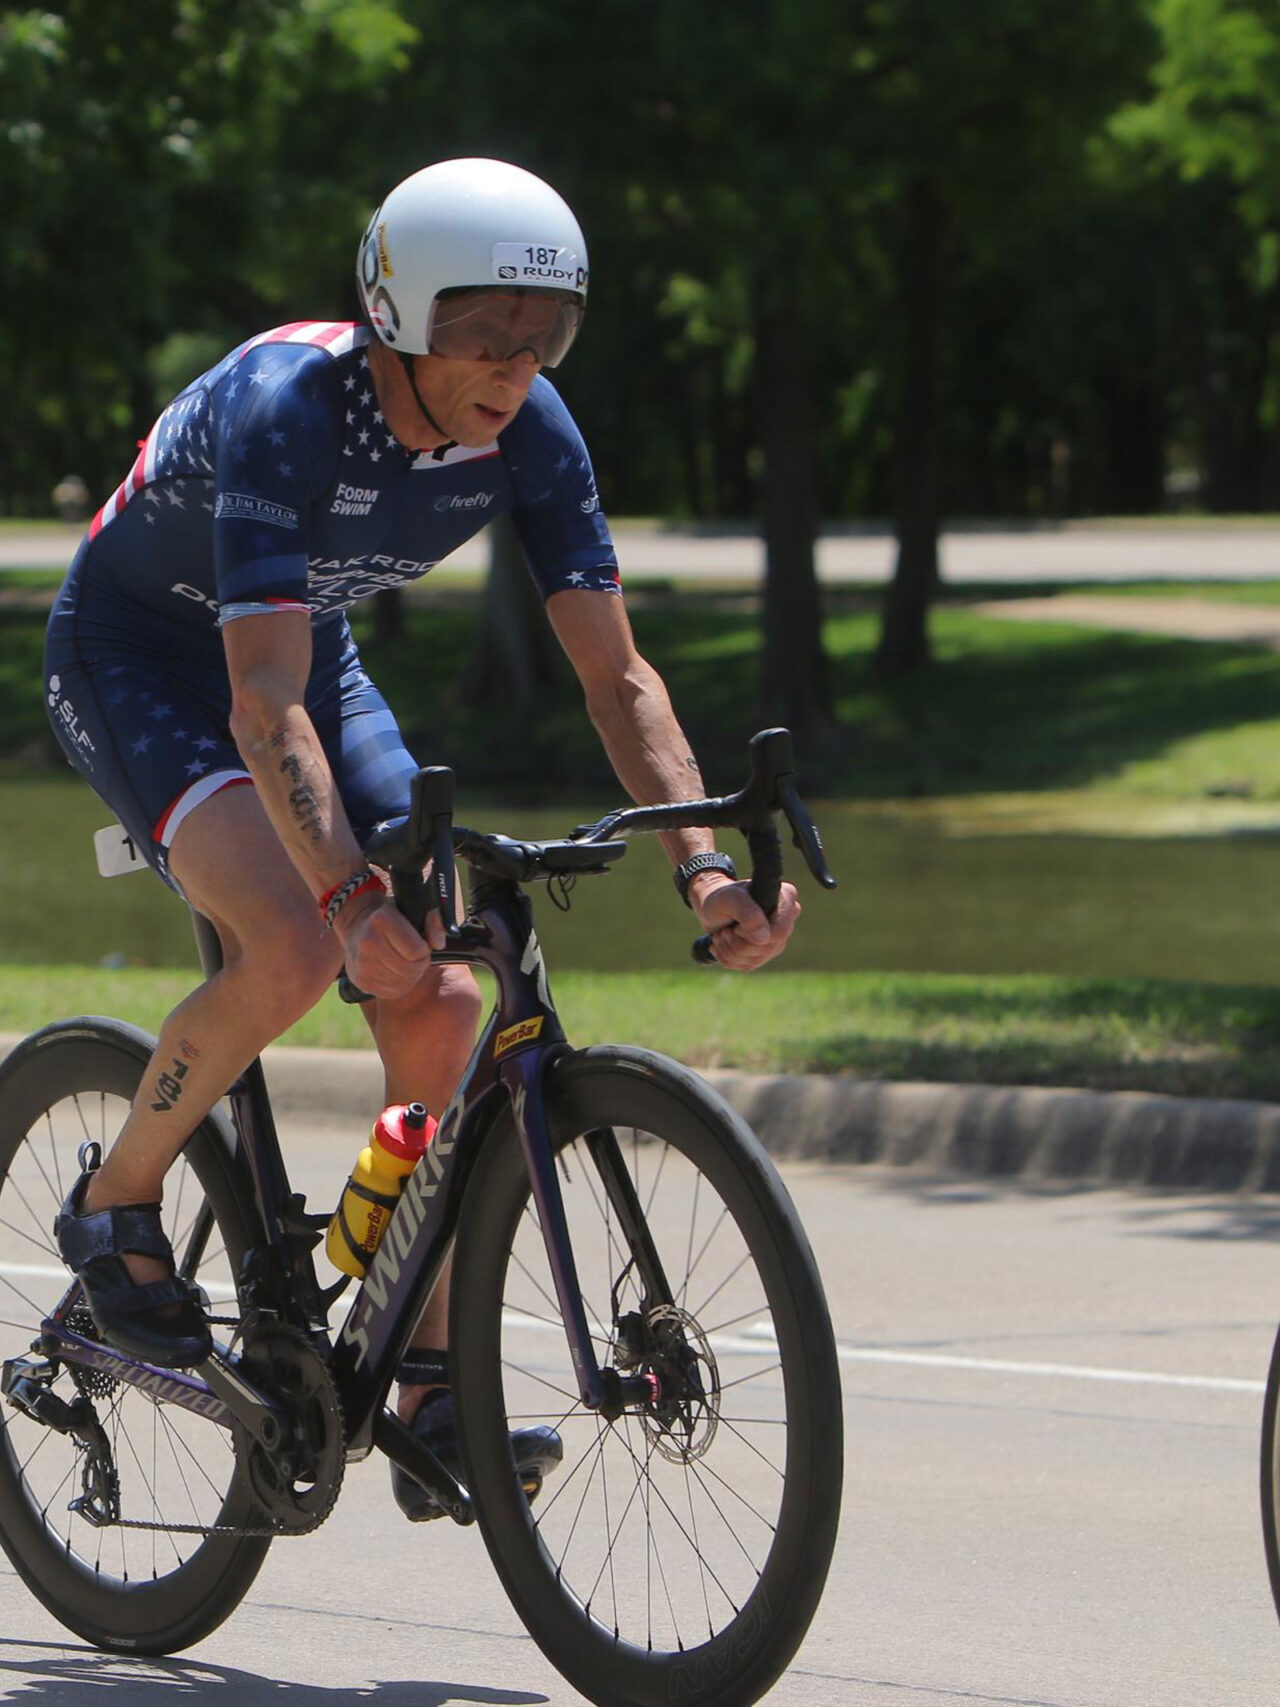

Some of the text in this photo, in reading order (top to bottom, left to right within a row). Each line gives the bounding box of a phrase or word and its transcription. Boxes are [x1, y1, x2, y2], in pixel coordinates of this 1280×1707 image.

[525, 247, 558, 266] 187
[523, 267, 574, 280] RUDY
[336, 482, 379, 503] FORM
[449, 491, 494, 508] firefly
[330, 499, 373, 516] SWIM
[344, 1095, 465, 1372] S-WORKS
[94, 1352, 228, 1418] SPECIALIZED
